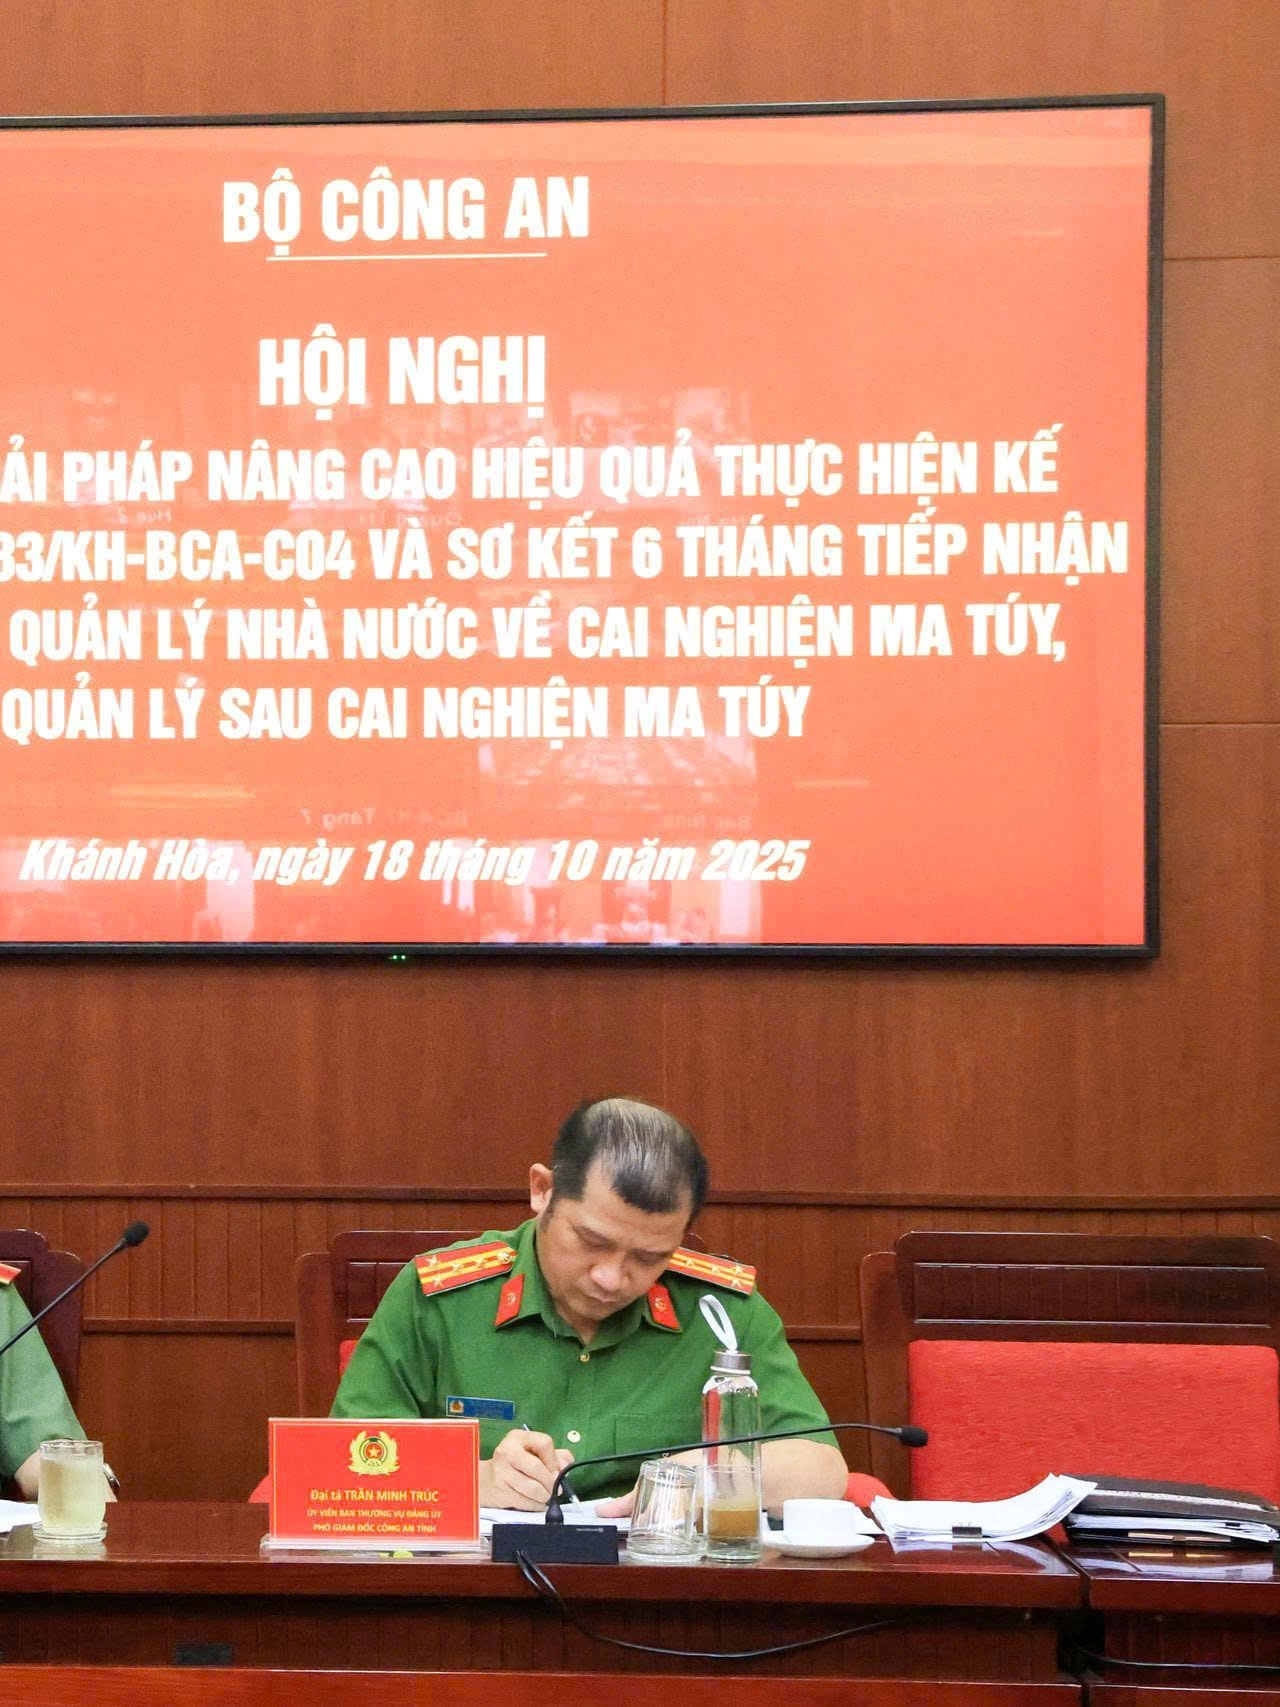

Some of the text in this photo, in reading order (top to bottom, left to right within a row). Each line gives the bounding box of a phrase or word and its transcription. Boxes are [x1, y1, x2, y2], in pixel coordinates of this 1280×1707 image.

[223, 167, 589, 256] BỘ CÔNG AN
[260, 324, 545, 420] HỘI NGHỊ
[63, 440, 192, 504] PHÁP
[208, 439, 345, 502] NÂNG
[360, 447, 457, 502] CAO
[472, 440, 584, 510] HIỆU
[599, 428, 699, 504] QUẢ
[713, 439, 842, 507] THỰC
[859, 431, 977, 505] HIỆN
[994, 423, 1061, 492] KẾ
[369, 517, 433, 579] VÀ
[447, 522, 514, 579] SƠ
[528, 511, 618, 578] KẾT
[632, 527, 662, 578] 6
[676, 514, 842, 577] THÁNG
[857, 507, 967, 576] TIẾP
[983, 511, 1127, 585] NHẬN
[10, 592, 141, 666] QUẢN
[157, 599, 212, 660] LÝ
[227, 598, 328, 659] NHÀ
[343, 598, 478, 659] NƯỚC
[492, 590, 551, 658] VỀ
[568, 606, 648, 658] CAI
[665, 595, 853, 668] NGHIỆN
[870, 604, 951, 656] MA
[966, 592, 1065, 661] TÚY,
[2, 671, 810, 749] QUẢN LÝ SAU CAI NGHIỆN MA TÚY
[19, 839, 809, 887] Khánh Hòa, ngày 18 tháng 10 năm 2025
[310, 1489, 329, 1503] Đại
[331, 1490, 342, 1501] tá
[376, 1490, 407, 1501] MINH
[410, 1488, 439, 1501] TRÚC
[339, 1507, 356, 1518] BAN
[402, 1522, 414, 1533] AN
